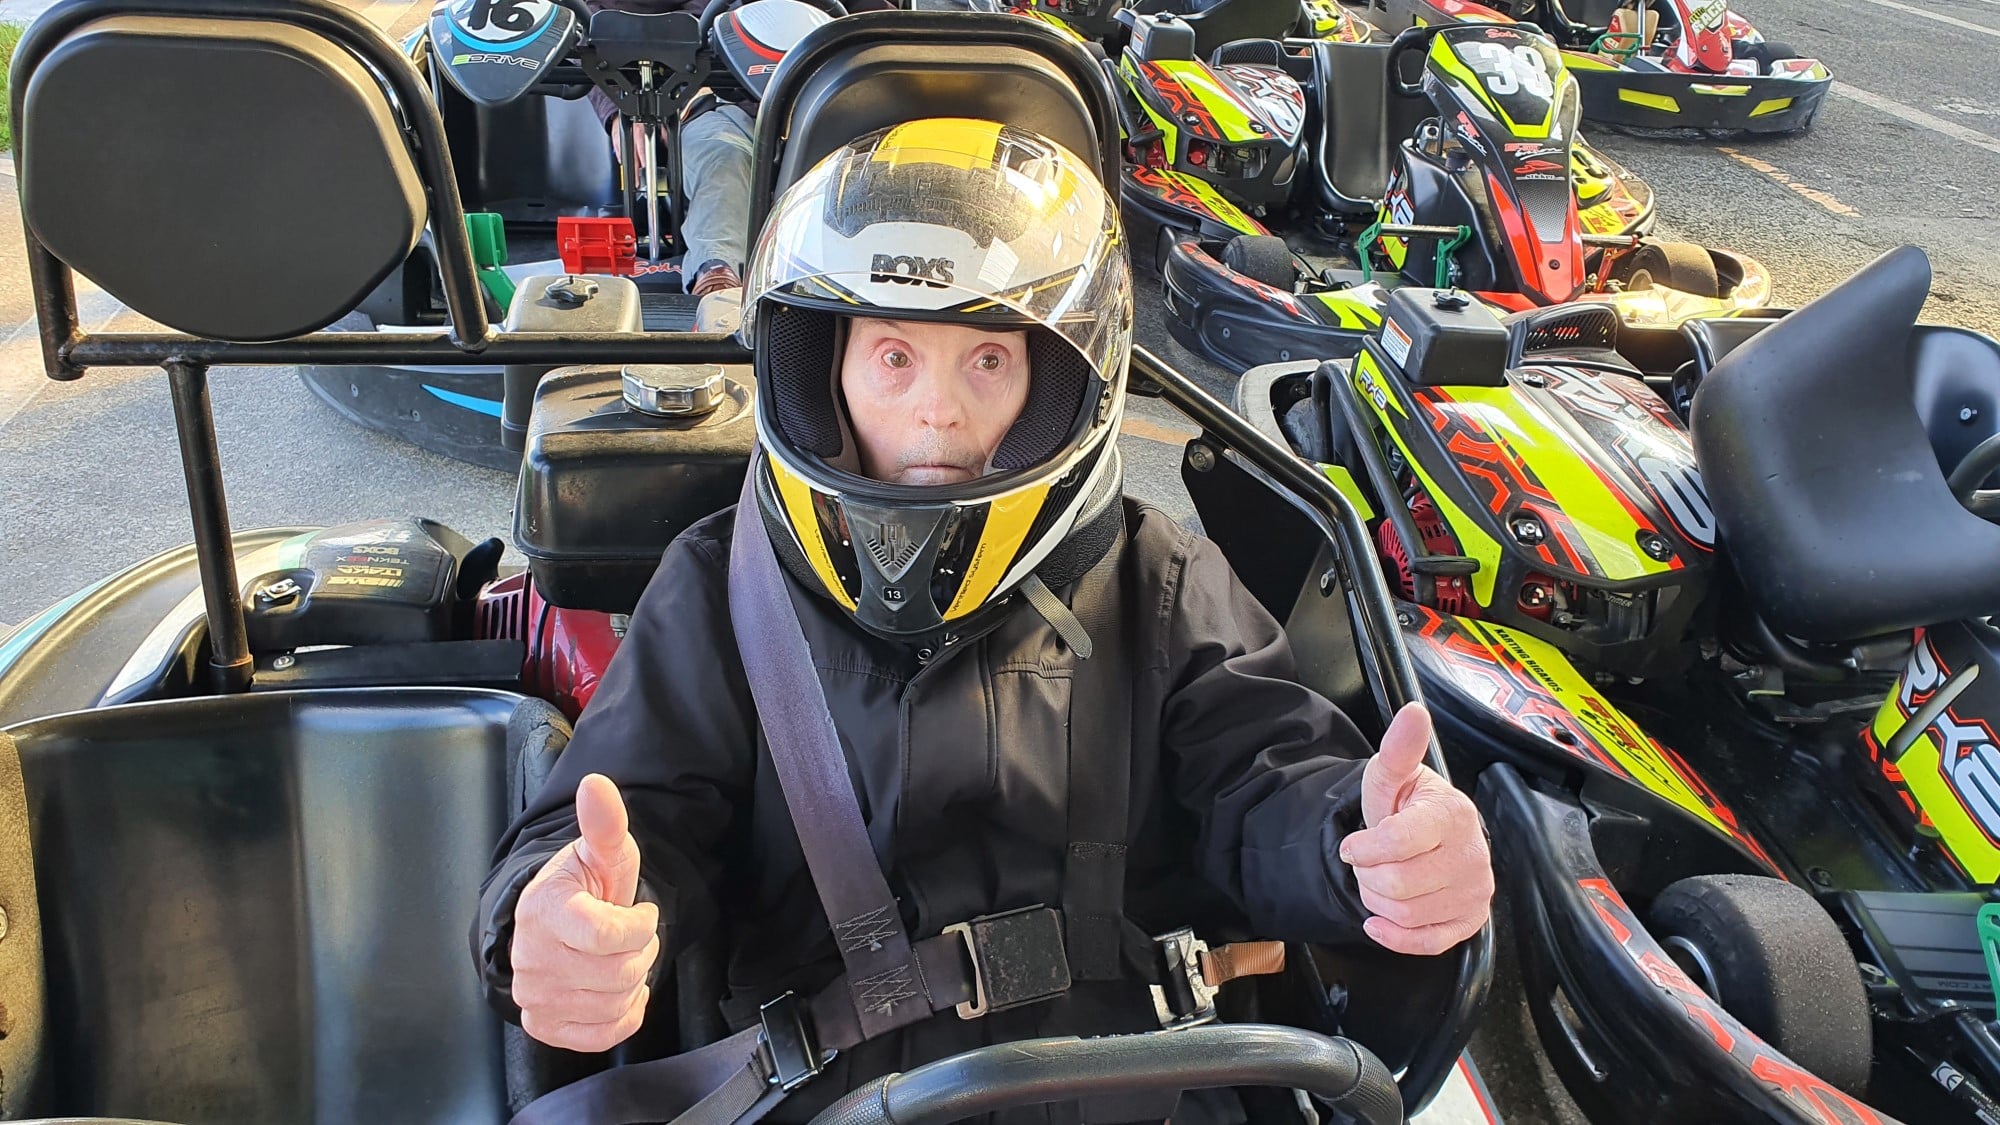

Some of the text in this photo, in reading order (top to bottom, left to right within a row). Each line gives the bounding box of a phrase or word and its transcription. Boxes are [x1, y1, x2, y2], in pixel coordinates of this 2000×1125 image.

[869, 253, 955, 289] BOXS
[887, 590, 901, 600] 13
[1494, 628, 1531, 660] KARTING
